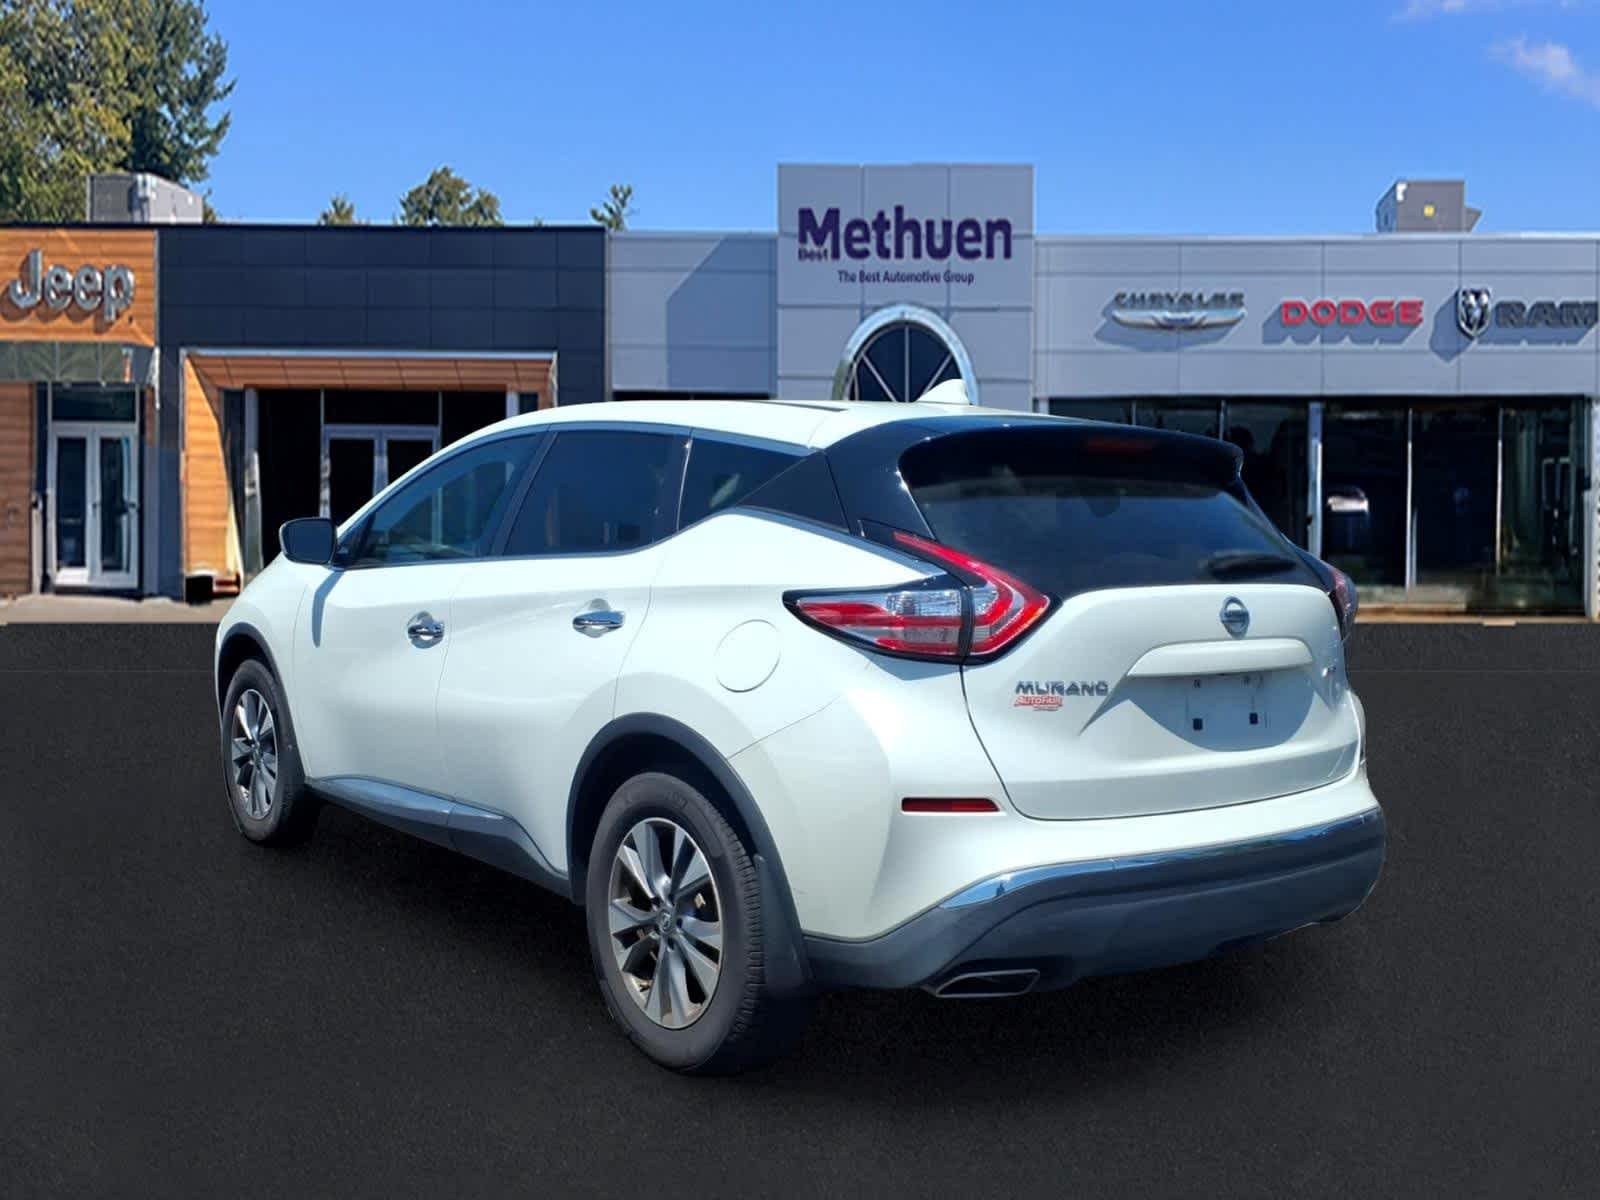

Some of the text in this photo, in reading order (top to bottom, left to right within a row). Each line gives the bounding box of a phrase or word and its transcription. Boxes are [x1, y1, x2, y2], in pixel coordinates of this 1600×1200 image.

[798, 205, 1012, 260] Methuen
[9, 249, 135, 320] Jeep
[837, 270, 975, 286] The Best Automotive Group
[1113, 292, 1245, 309] CHRYSLER
[1281, 300, 1424, 326] DODGE
[1495, 301, 1599, 328] RAM
[1015, 680, 1109, 696] MURANO
